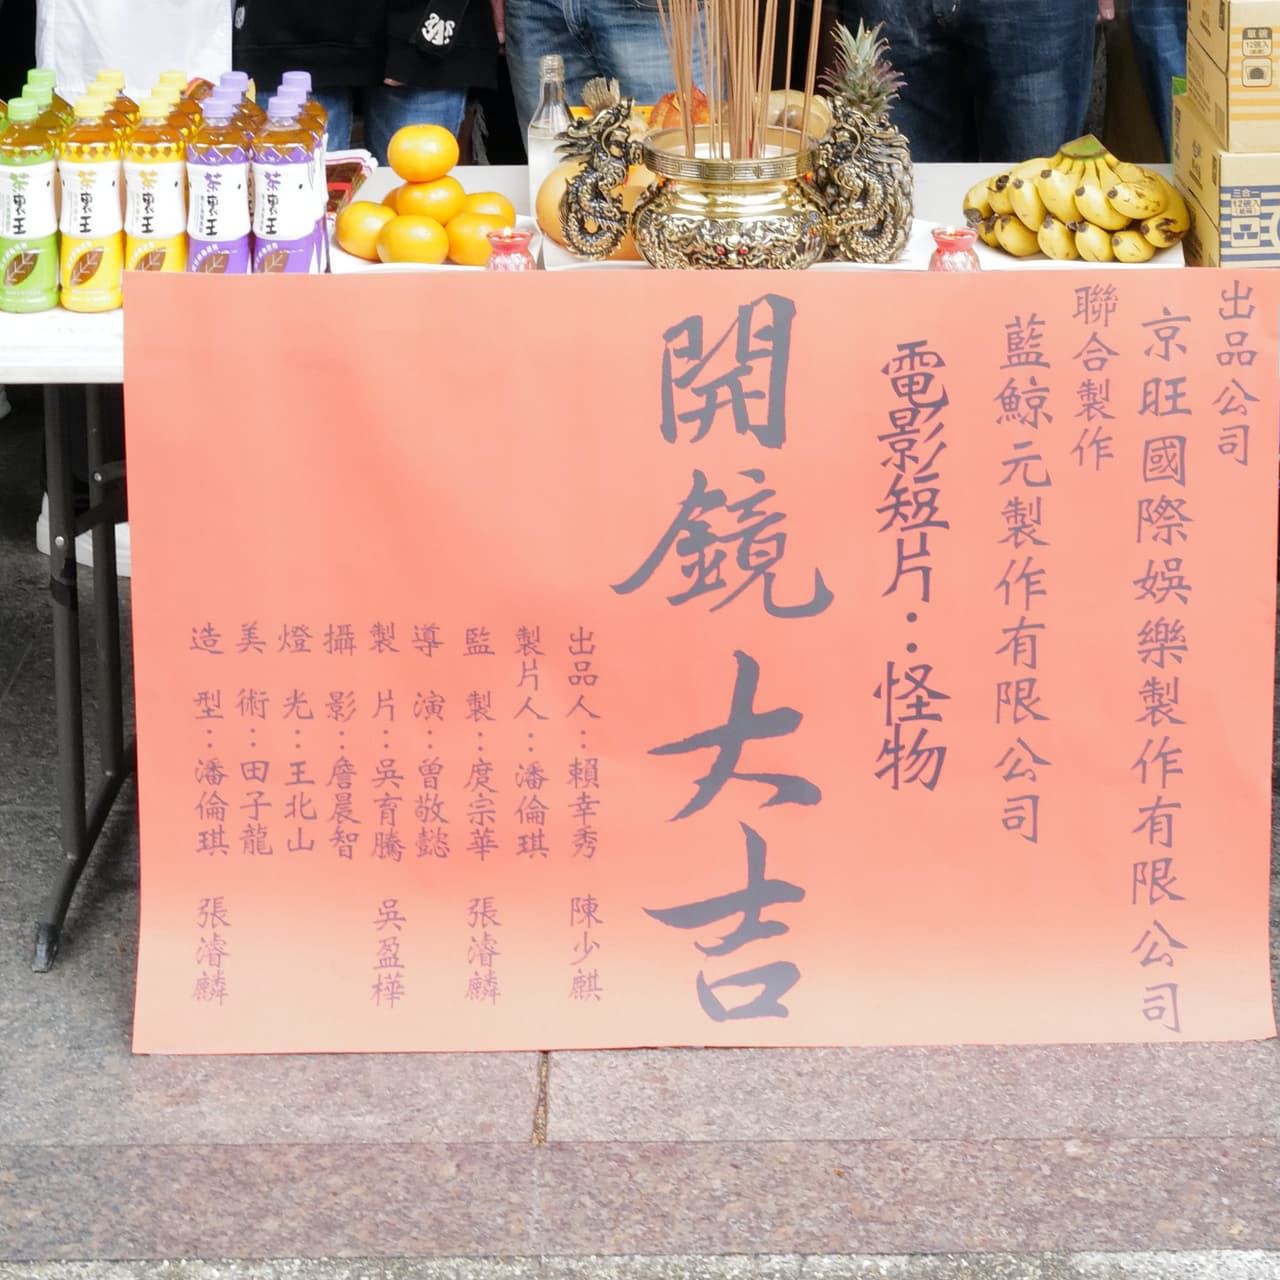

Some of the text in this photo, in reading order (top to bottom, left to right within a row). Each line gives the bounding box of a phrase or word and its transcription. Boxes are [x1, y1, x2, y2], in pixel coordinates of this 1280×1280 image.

[993, 312, 1053, 844] 藍鯨元製作有限公司
[1072, 284, 1120, 471] 聯合製作
[1212, 279, 1260, 466] 出品公司
[609, 293, 835, 1022] 開鏡大吉
[1131, 307, 1193, 1033] 京旺國際娛樂製作有限公司
